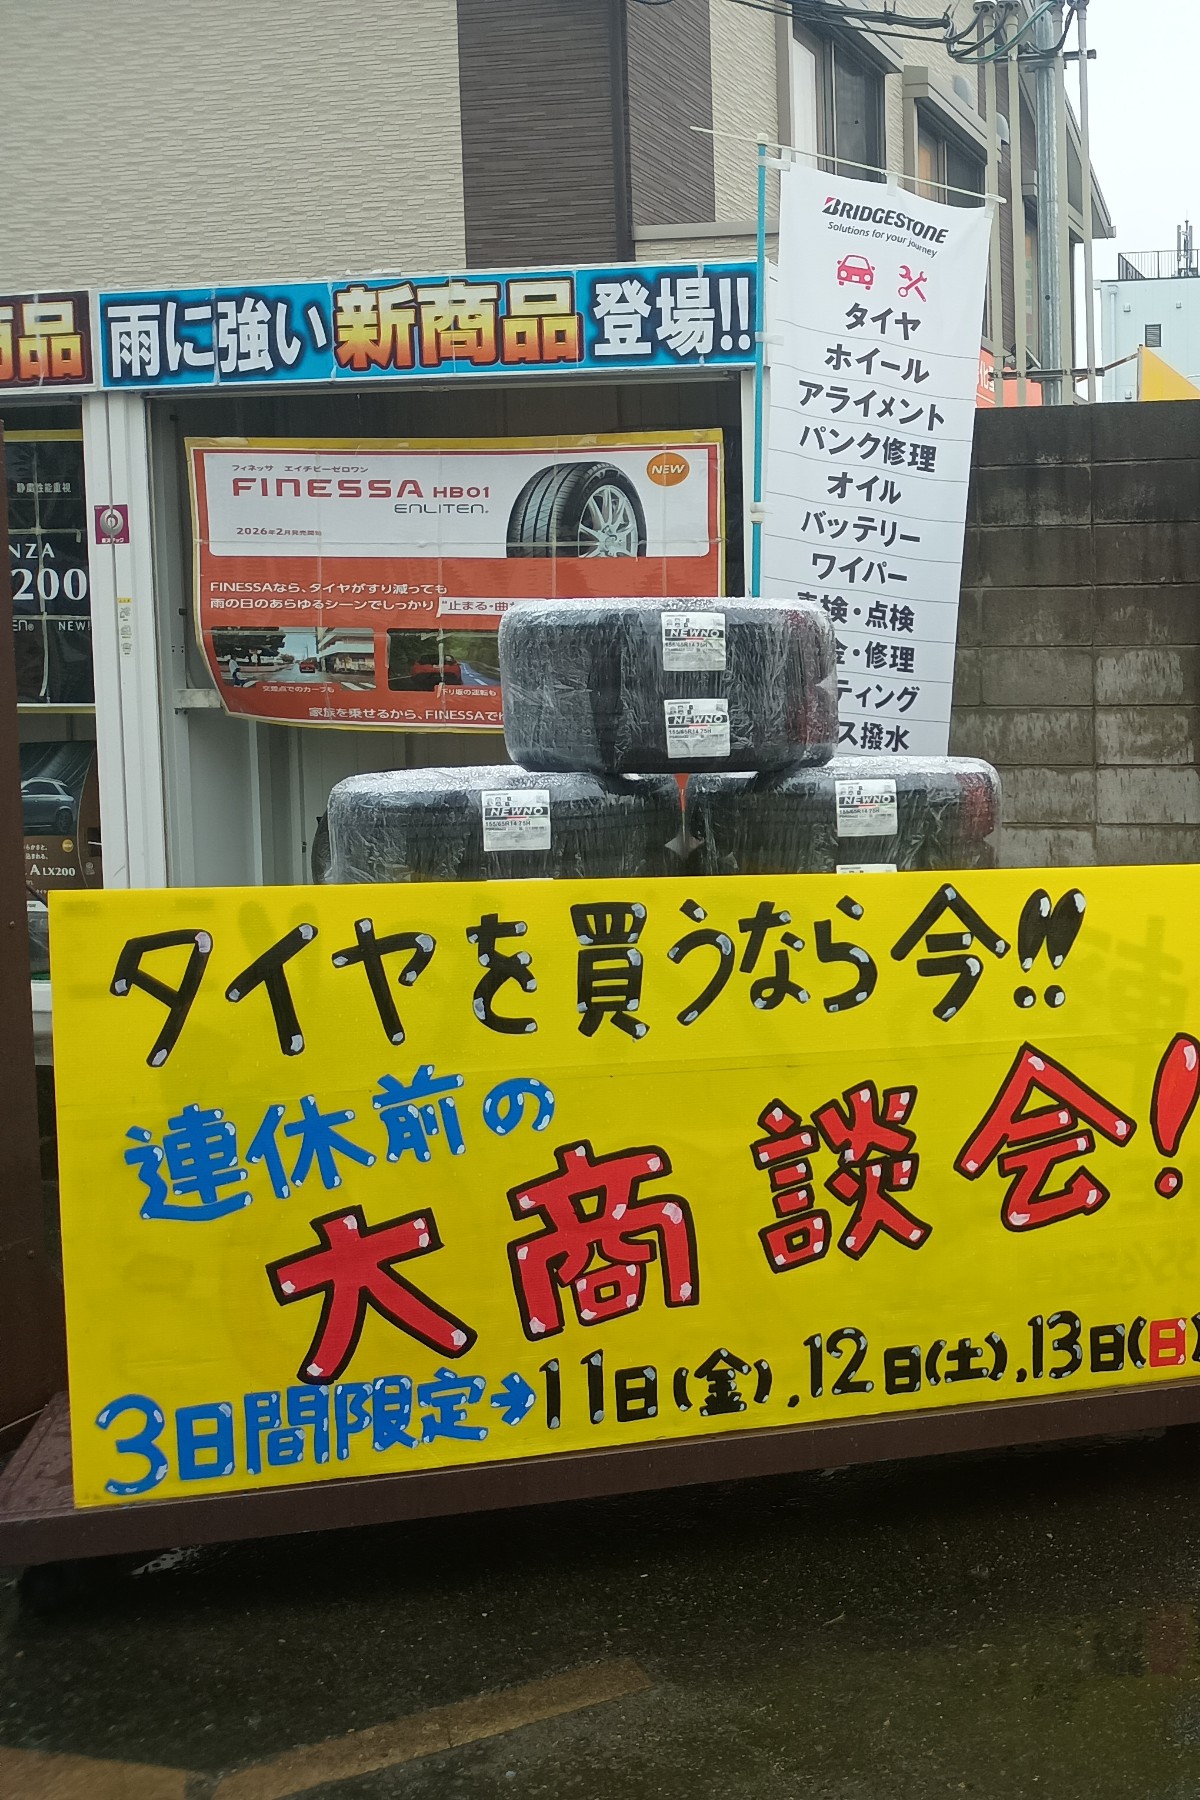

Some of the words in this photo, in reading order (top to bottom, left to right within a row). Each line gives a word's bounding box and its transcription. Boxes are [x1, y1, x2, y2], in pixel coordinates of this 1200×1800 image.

[822, 196, 949, 244] BRIDGESTONE
[828, 221, 870, 238] Solutions
[871, 229, 886, 241] for
[885, 232, 907, 246] your
[907, 236, 938, 258] journey
[845, 302, 921, 341] タイヤ
[824, 343, 930, 384] ホイール
[799, 379, 945, 432] アライメント
[799, 425, 936, 473] パンク修理
[232, 464, 274, 473] フィネッサ
[651, 464, 686, 475] NEW
[232, 477, 424, 499] FINESSA
[432, 485, 490, 499] HB01
[827, 472, 902, 504] オイル
[801, 511, 920, 547] バッテリー
[812, 553, 907, 584] ワイパー
[210, 582, 448, 595] FINESSAなら、タイヤがすり減っても
[210, 598, 434, 611] 雨の日のあらゆるシーンでしっかり
[670, 628, 720, 638] NEWNO
[674, 715, 724, 725] NEWNO
[490, 807, 544, 817] NEWNO
[843, 795, 891, 804] NEWNO
[110, 883, 1083, 1068] タイヤを買うなら今!!
[124, 1063, 556, 1223] 連休前の
